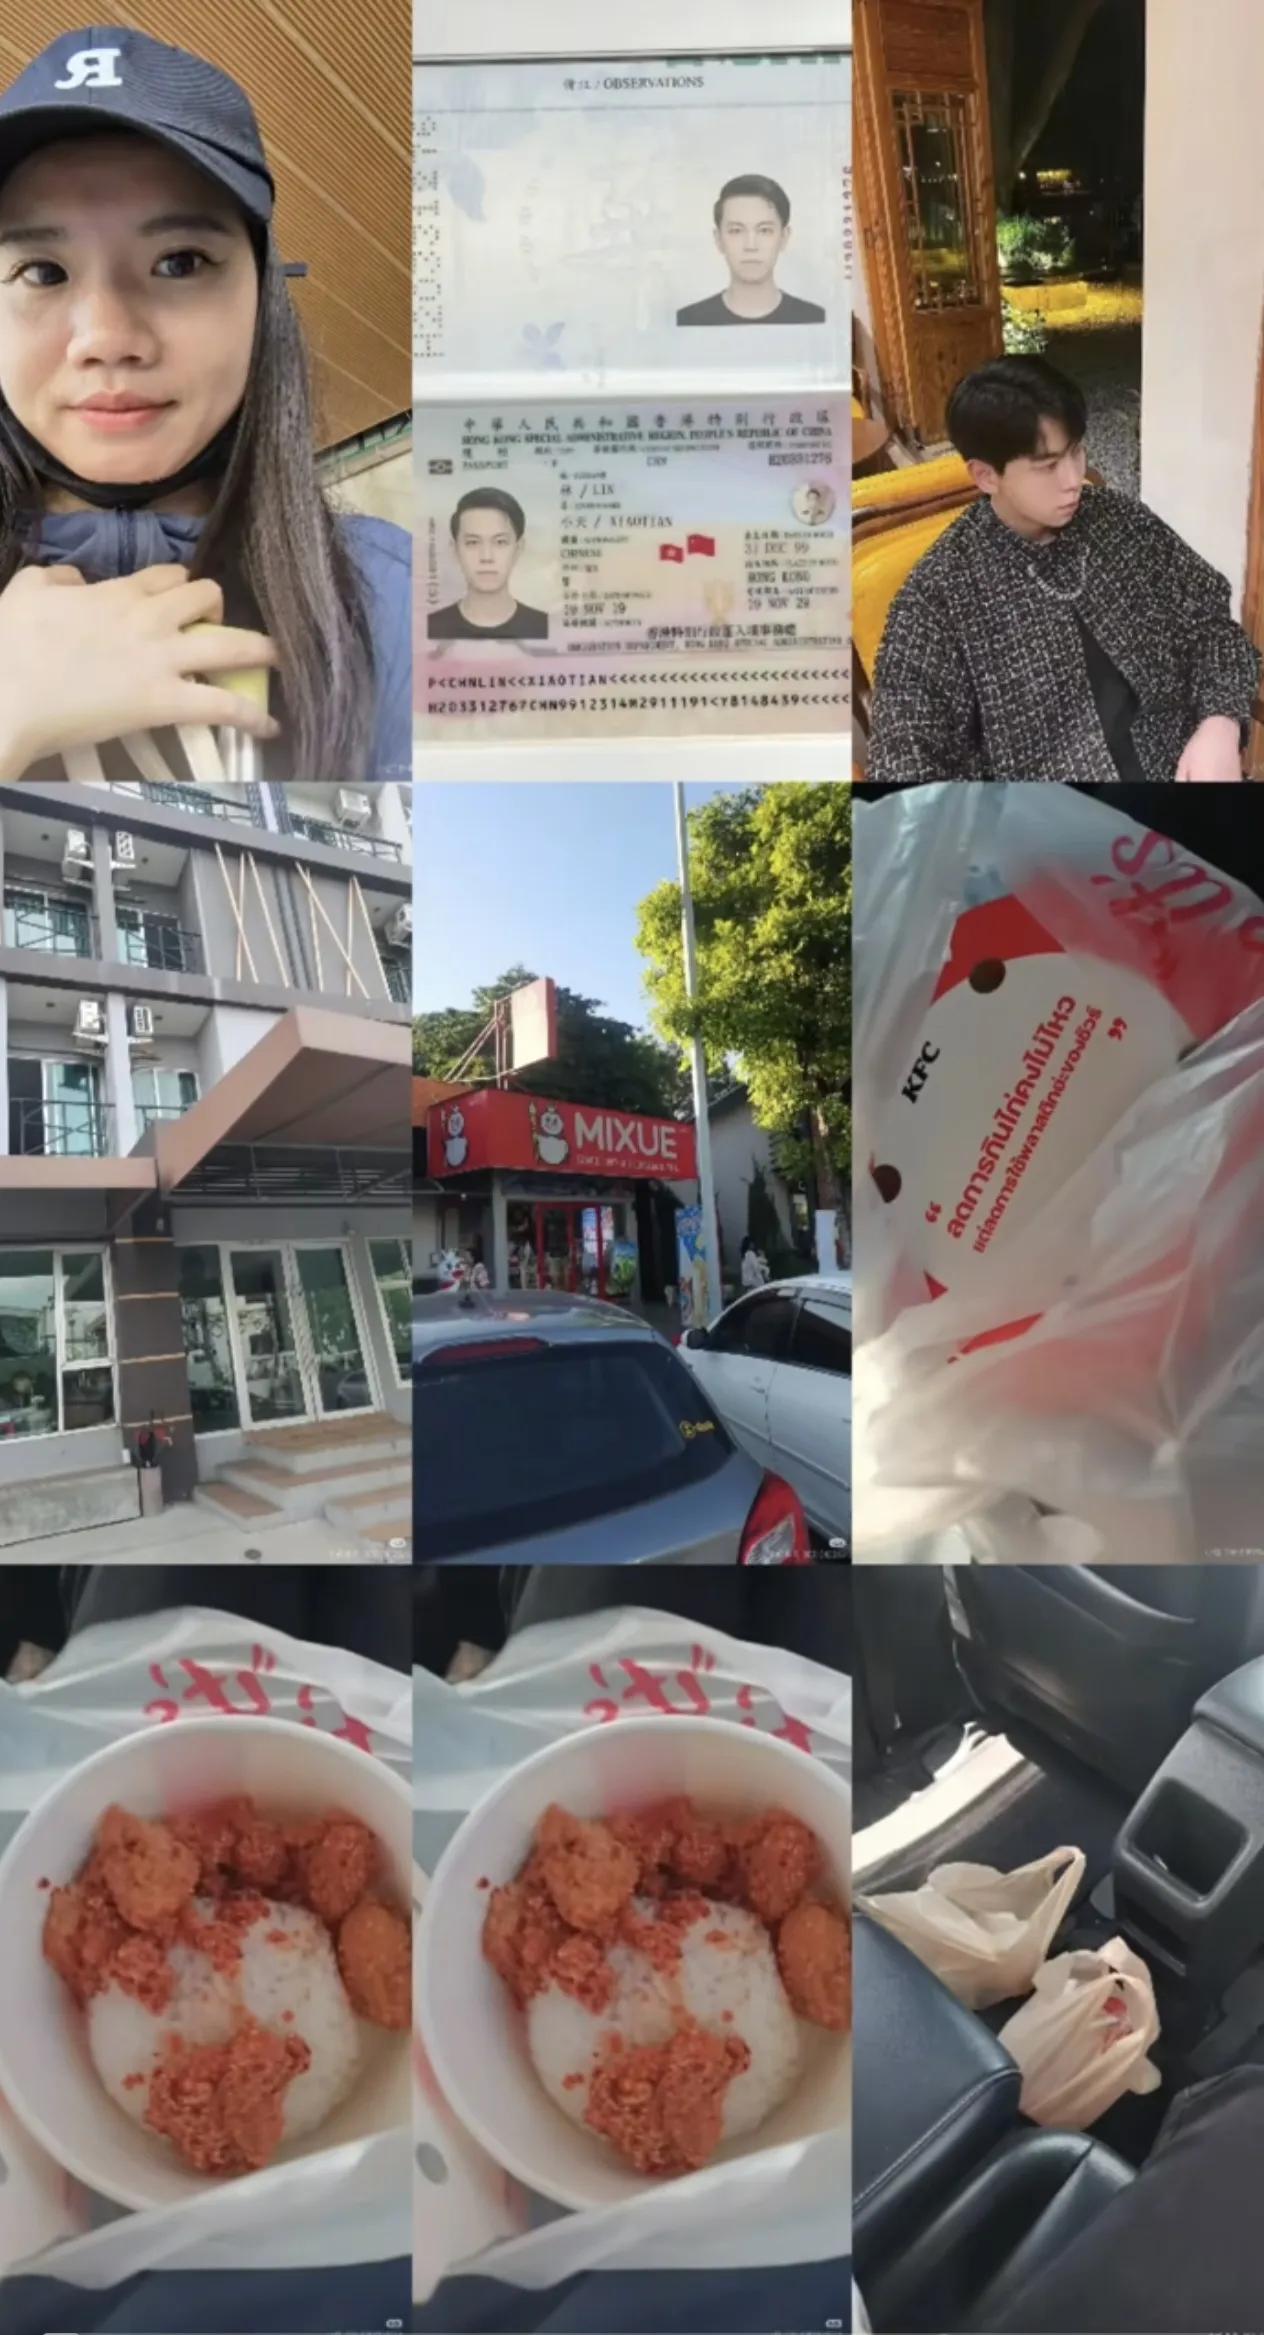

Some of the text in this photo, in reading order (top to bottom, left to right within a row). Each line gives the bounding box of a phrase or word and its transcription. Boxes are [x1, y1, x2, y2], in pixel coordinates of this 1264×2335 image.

[603, 76, 705, 90] OBSERVATIONS
[461, 434, 490, 446] HONG
[493, 433, 521, 445] KONG
[592, 484, 615, 496] LIN
[901, 1040, 940, 1104] KFC
[574, 1111, 678, 1159] MIXUE
